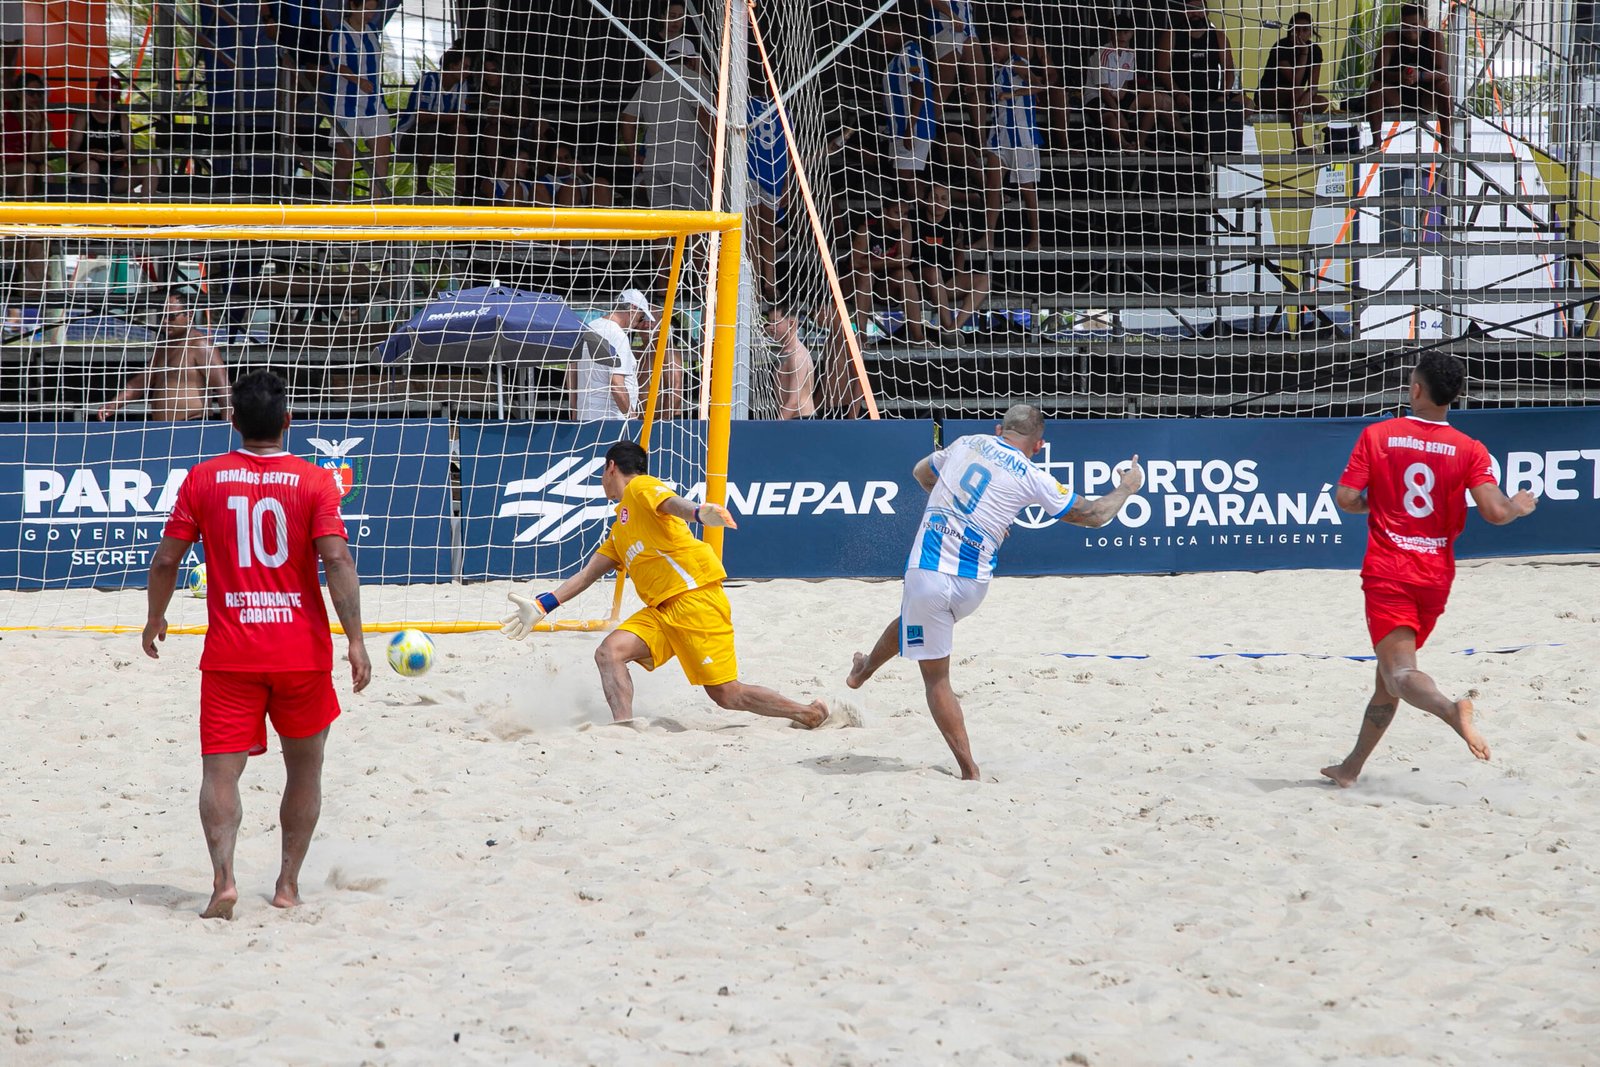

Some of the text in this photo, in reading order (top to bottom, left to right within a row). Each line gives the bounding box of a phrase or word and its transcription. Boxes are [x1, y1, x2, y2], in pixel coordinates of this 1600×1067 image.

[758, 117, 777, 150] 8
[1388, 435, 1456, 456] IRMÃOS BENTTI
[24, 469, 188, 513] PARA
[216, 468, 300, 487] IRMÃOS BENTTI
[953, 462, 993, 515] 9
[1084, 459, 1259, 494] PORTOS
[1403, 462, 1435, 518] 8
[664, 480, 899, 516] NEPAR
[1164, 482, 1342, 527] PARANÁ
[24, 528, 166, 541] GOVERN
[227, 495, 288, 568] 10
[1085, 534, 1342, 547] LOGÍSTICA INTELIGENTE
[71, 550, 200, 565] SECRETA
[225, 591, 301, 608] RESTAURANTE
[239, 607, 293, 624] GABIATTI
